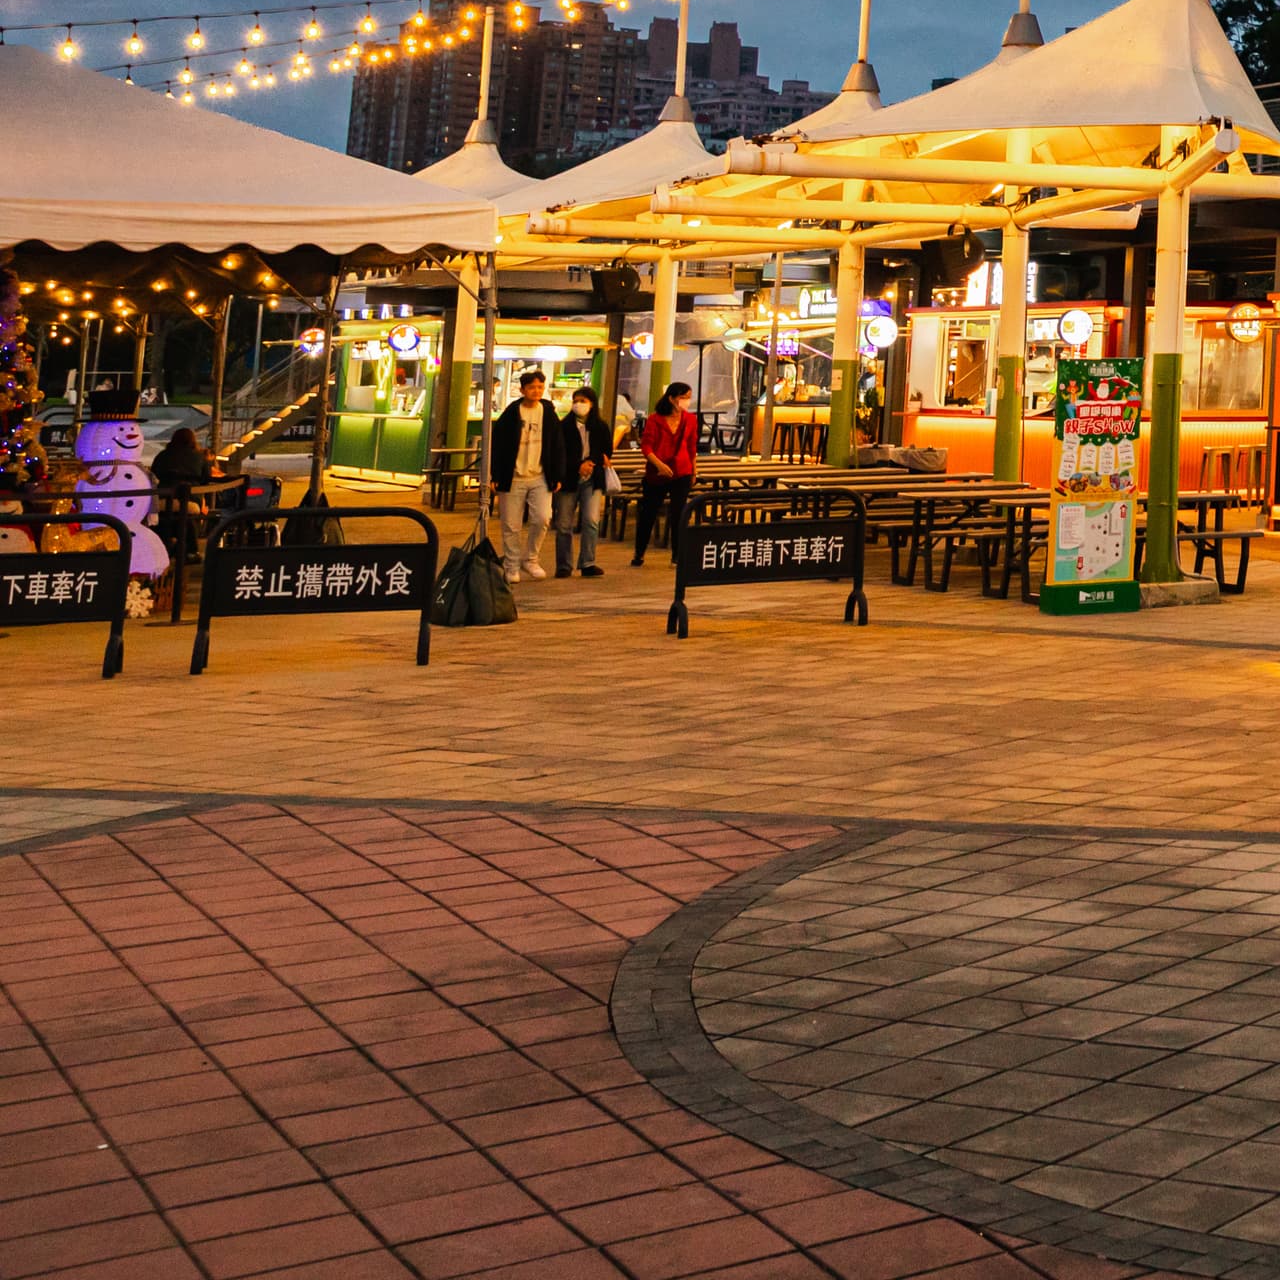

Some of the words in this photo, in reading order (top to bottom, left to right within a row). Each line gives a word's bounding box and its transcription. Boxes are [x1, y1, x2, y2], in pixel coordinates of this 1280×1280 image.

[702, 535, 845, 570] 自行車請下車牽行
[3, 570, 98, 605] 下車牽行
[234, 561, 413, 599] 禁止攜帶外食
